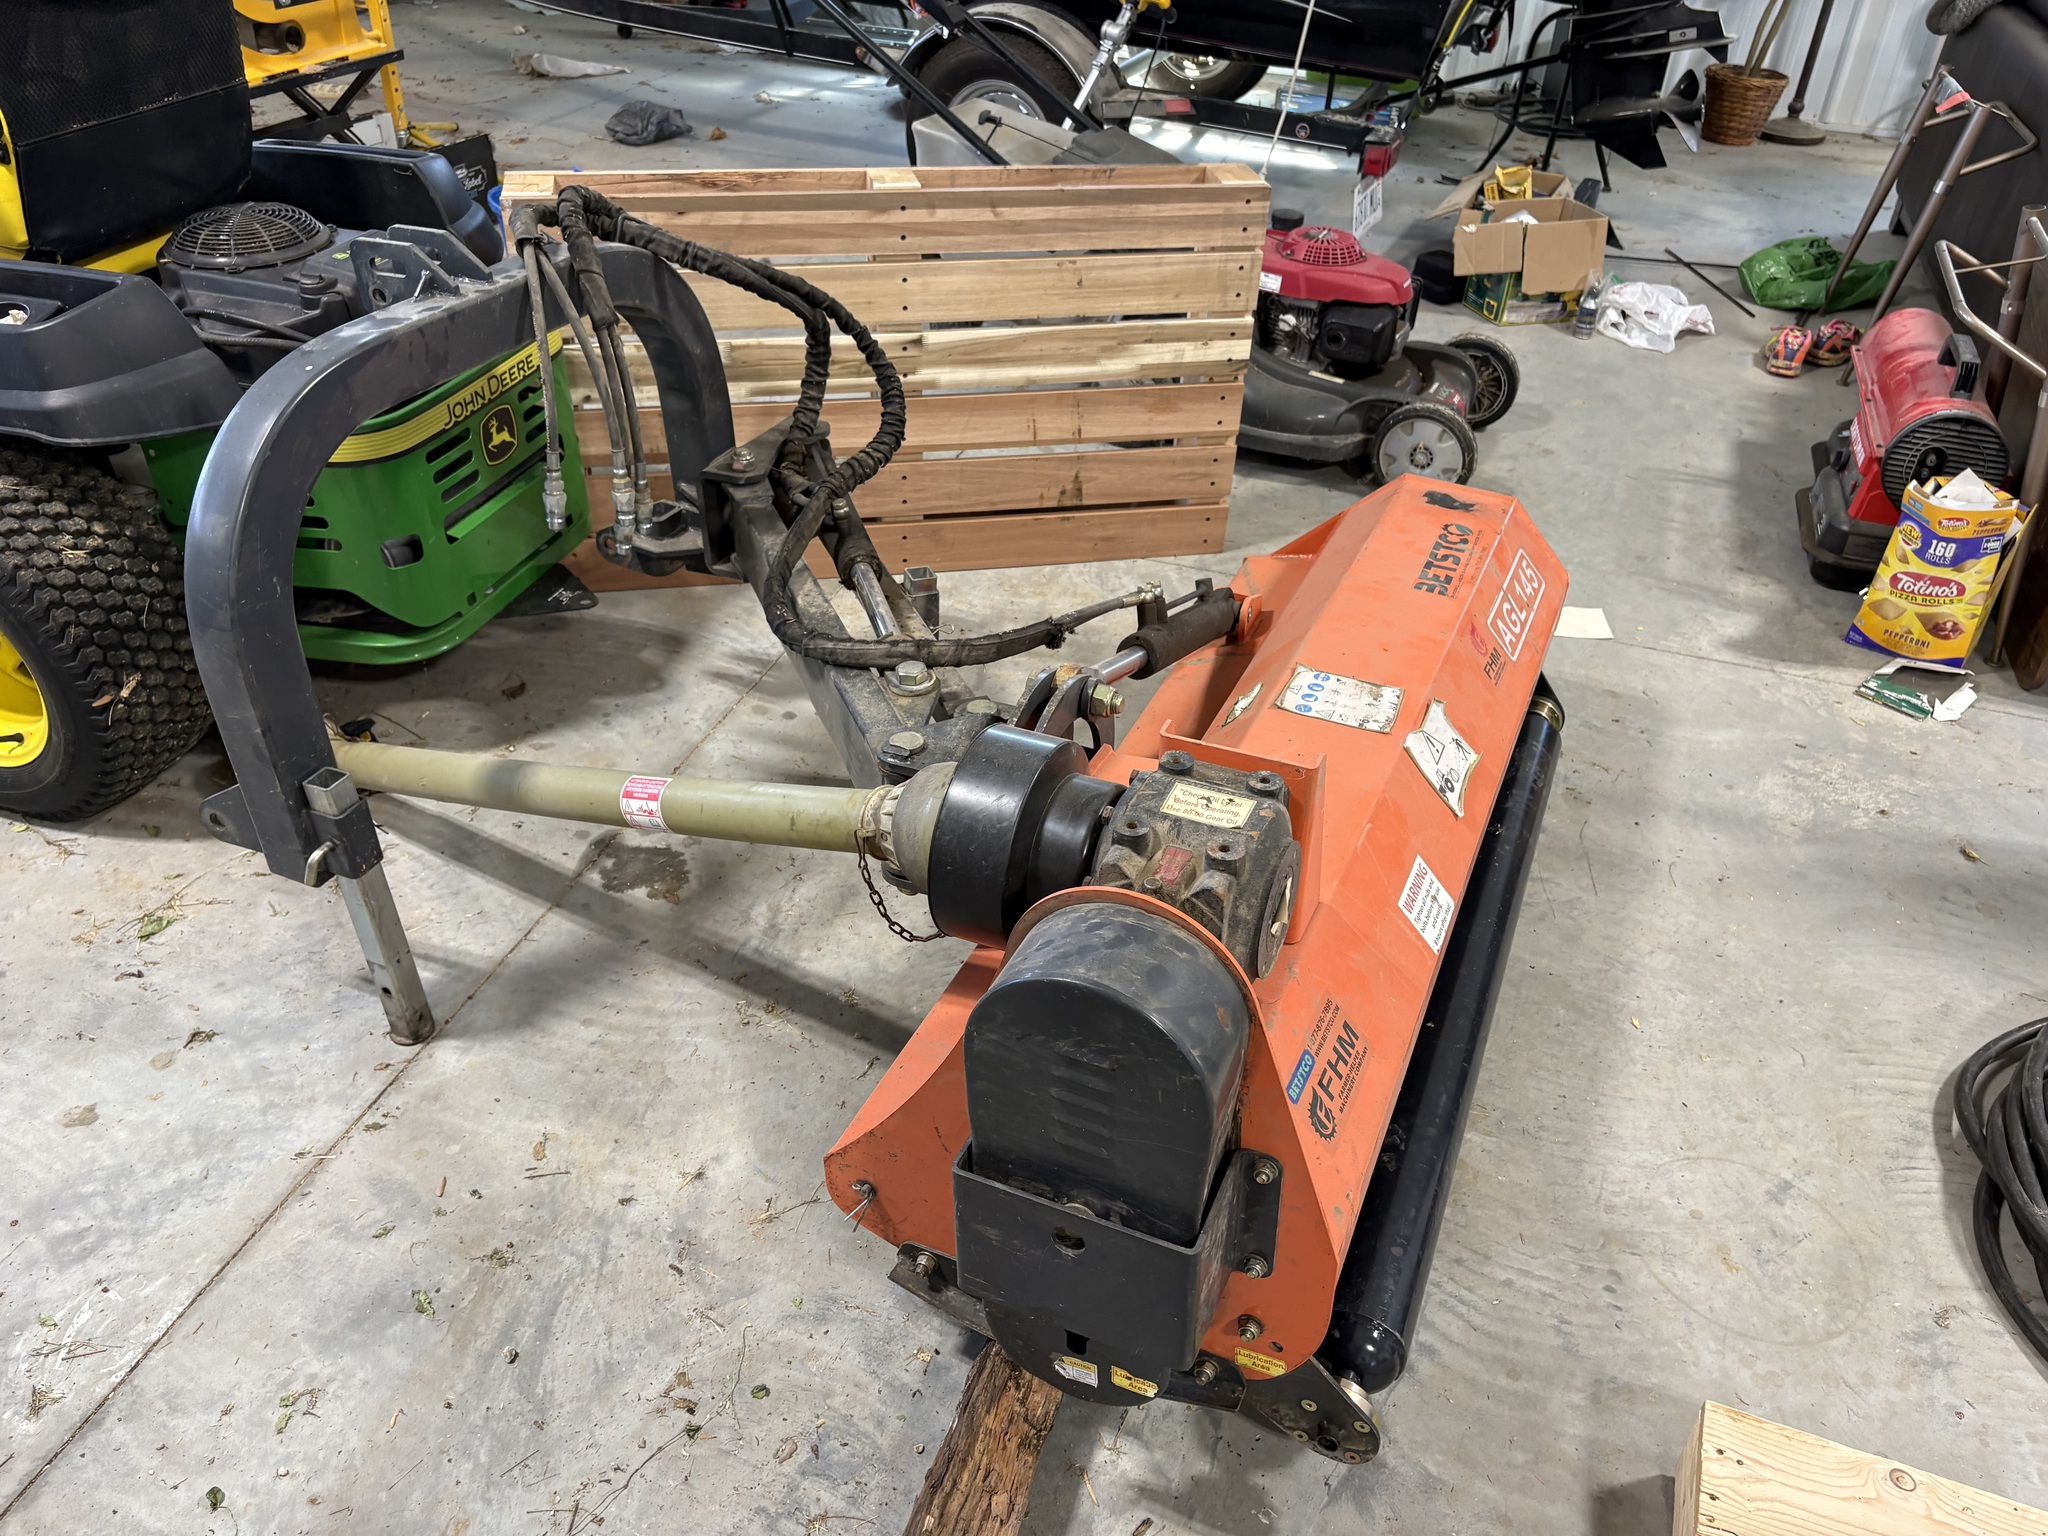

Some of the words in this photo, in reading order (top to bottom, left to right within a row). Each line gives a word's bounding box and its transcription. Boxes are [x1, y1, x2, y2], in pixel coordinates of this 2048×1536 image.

[443, 386, 487, 427] JOHN
[487, 353, 536, 395] DEERE
[1413, 523, 1474, 597] BETSTCO
[1925, 552, 1952, 565] ROLLS
[1928, 539, 1957, 558] 160
[1896, 572, 1958, 598] Totino's
[1496, 585, 1527, 655] AGL
[1514, 558, 1541, 609] 145
[1889, 590, 1918, 603] PIZZA
[1921, 597, 1955, 606] ROLLS
[1883, 628, 1931, 649] PEPPERONI
[1483, 646, 1503, 680] FHM
[1166, 804, 1181, 813] Use
[1205, 814, 1225, 823] Gear
[1226, 817, 1239, 826] Oil
[1173, 797, 1199, 809] Before
[1402, 862, 1428, 914] WARNING
[1414, 904, 1425, 924] Tighten
[1315, 1004, 1340, 1058] WWW.BETSTCO.COM
[1317, 1020, 1360, 1102] FHM
[1288, 1053, 1313, 1100] BETSTCO
[1338, 1050, 1361, 1100] FARMER-HELPER
[1339, 1075, 1357, 1114] MACHINERY
[1353, 1046, 1369, 1077] COMPANY
[1069, 1360, 1092, 1371] CAUTION
[1238, 1349, 1285, 1370] Lubrication
[1251, 1360, 1271, 1372] Area
[1128, 1381, 1148, 1394] Area
